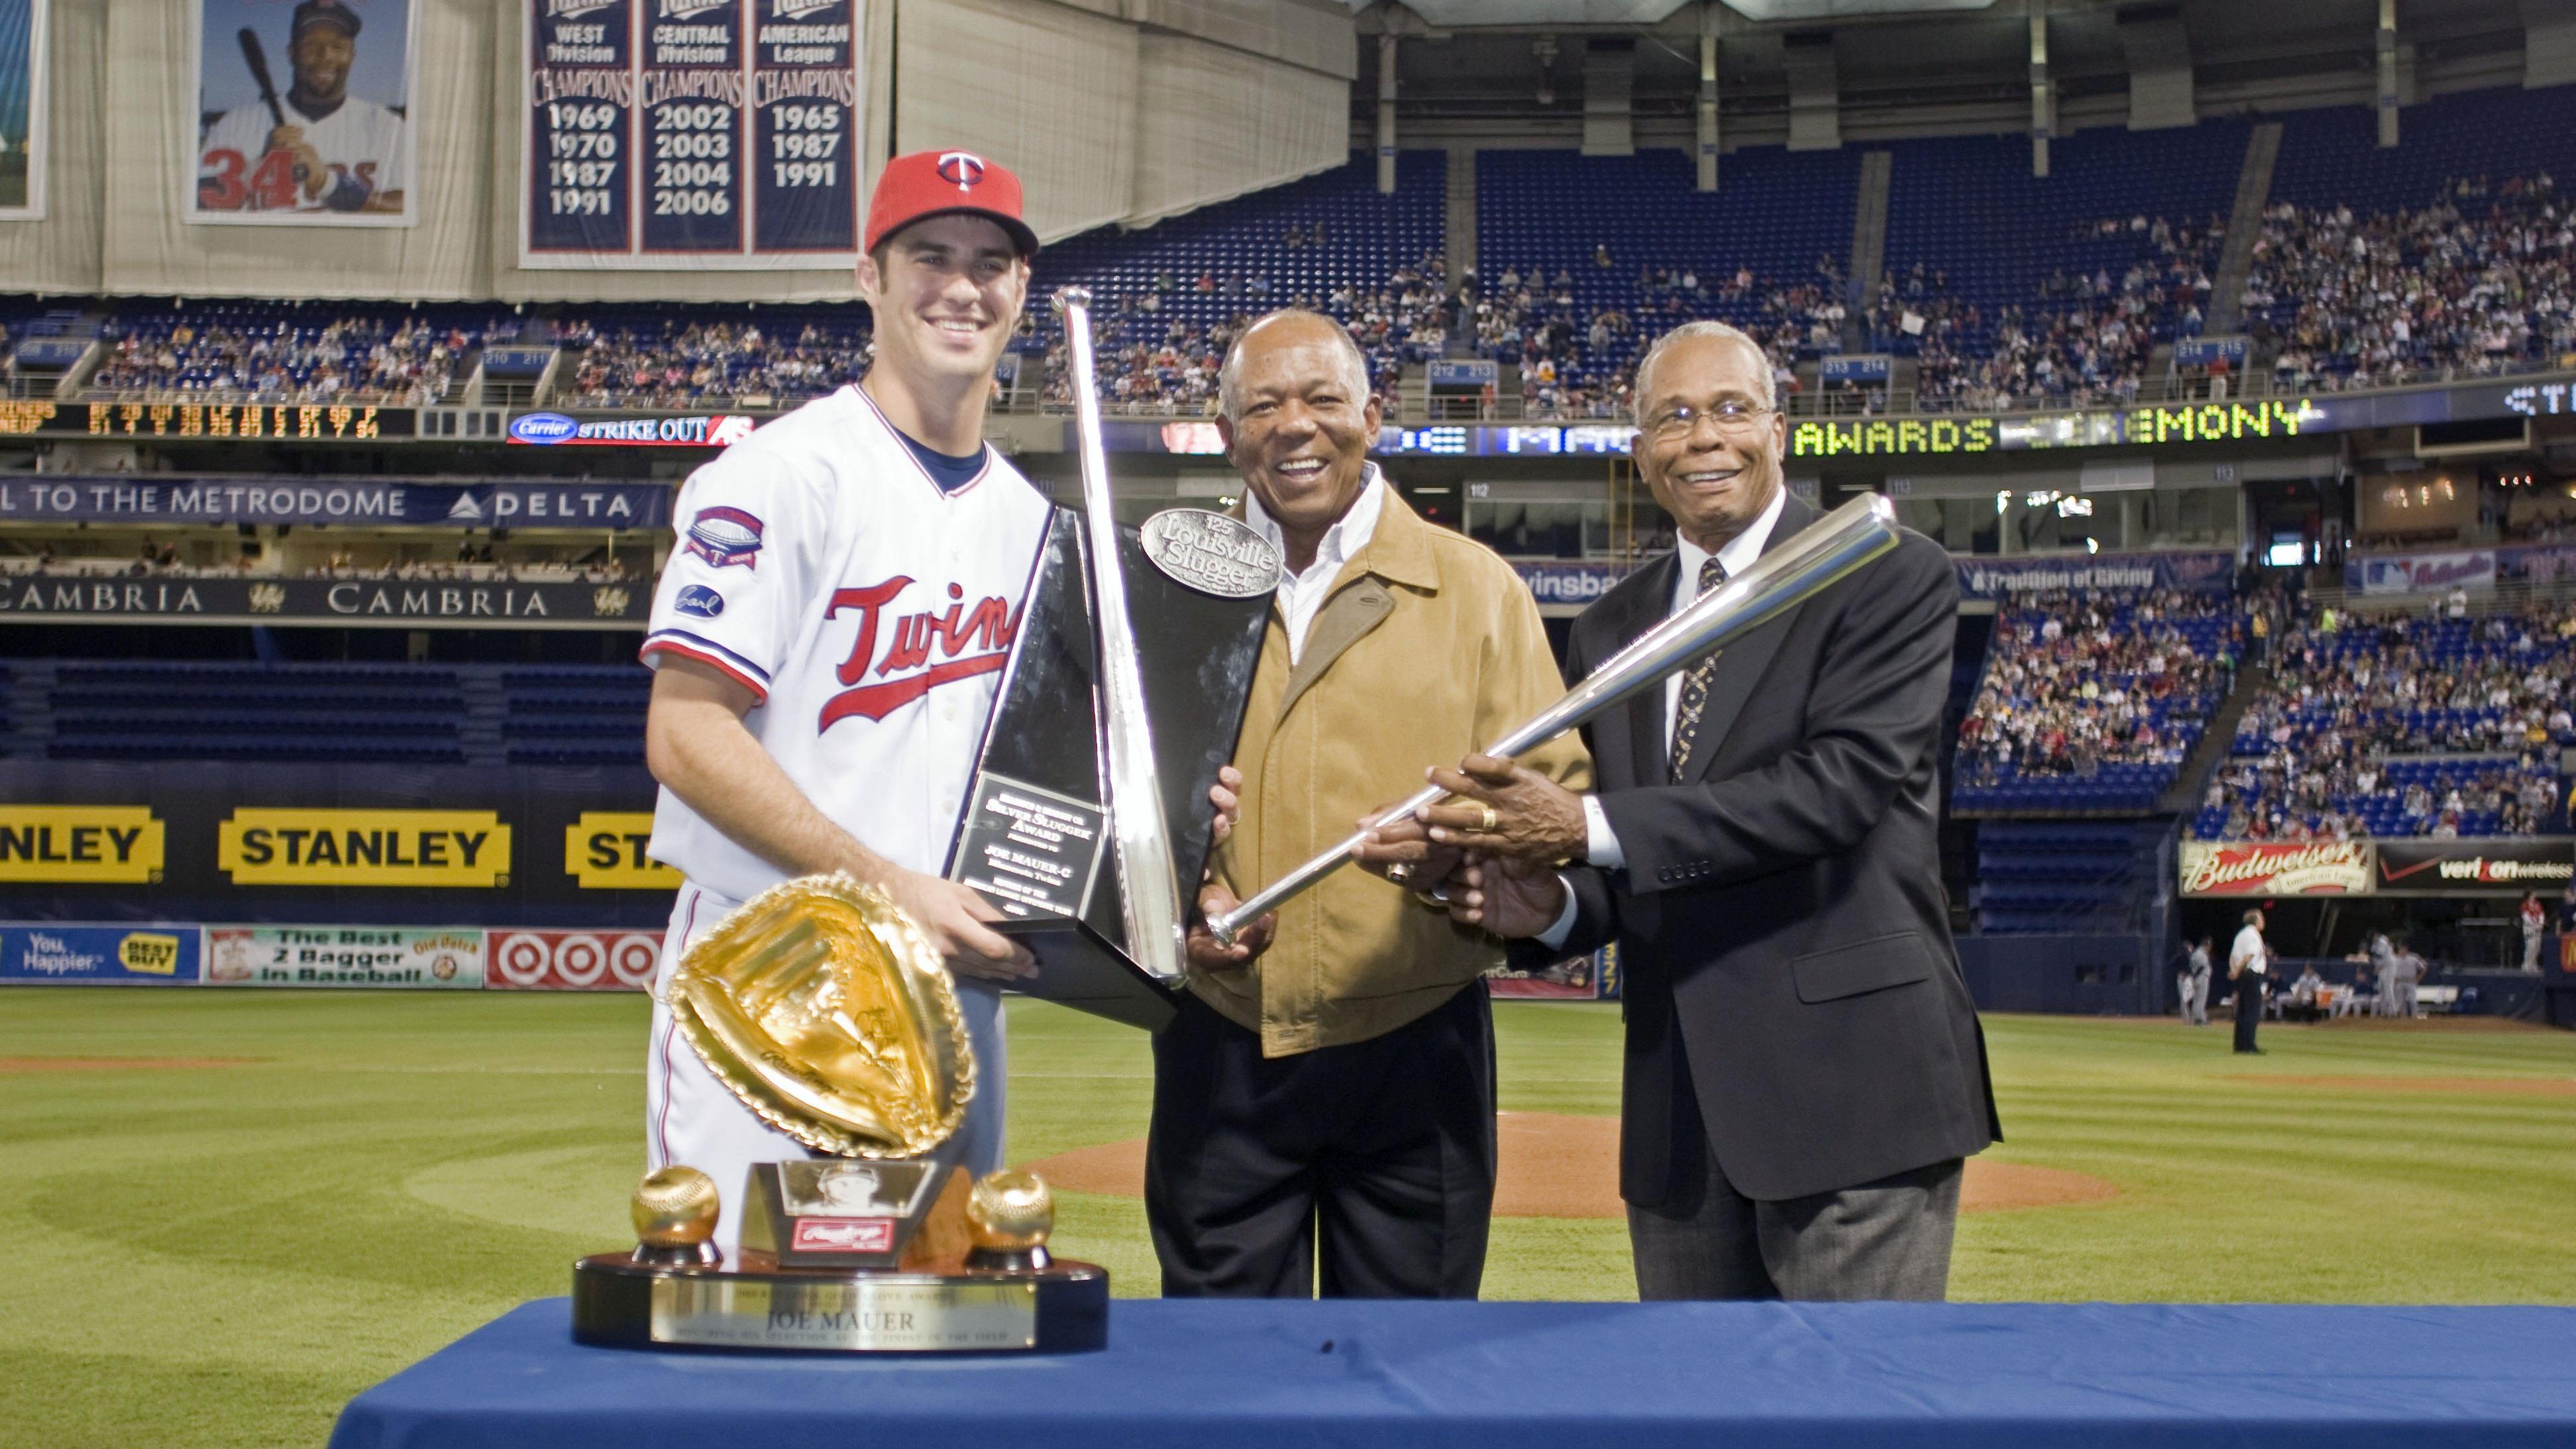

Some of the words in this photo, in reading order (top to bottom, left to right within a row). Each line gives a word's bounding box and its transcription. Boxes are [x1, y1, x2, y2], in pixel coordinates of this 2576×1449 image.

[555, 25, 606, 43] WEST
[653, 25, 729, 44] CENTRAL
[759, 25, 849, 44] AMERICAN
[547, 46, 615, 63] Division
[657, 46, 726, 63] Division
[774, 46, 836, 64] League
[531, 69, 632, 108] CHAMPIONS
[640, 69, 743, 109] CHAMPIONS
[753, 69, 855, 109] CHAMPIONS
[549, 104, 617, 130] 1969
[655, 105, 730, 130] 2002
[773, 105, 840, 130] 1965
[549, 133, 617, 158] 1970
[655, 134, 729, 158] 2003
[773, 133, 841, 158] 1987
[199, 148, 297, 210] 34
[549, 162, 617, 187] 1987
[655, 162, 730, 187] 2004
[774, 162, 837, 187] 1991
[549, 190, 611, 215] 1991
[655, 191, 729, 215] 2006
[486, 352, 508, 365] 210
[523, 352, 545, 365] 211
[1433, 365, 1455, 377] 212
[1825, 362, 1849, 373] 213
[996, 366, 1012, 379] 12
[299, 421, 320, 438] 21
[333, 423, 347, 439] 7
[518, 421, 570, 437] Carrier
[578, 419, 658, 439] STRIKE
[660, 417, 709, 442] OUT
[1794, 417, 1994, 456] AWARDS
[29, 486, 77, 512] TO
[89, 486, 158, 513] THE
[170, 486, 405, 515] METRODOME
[1470, 484, 1488, 497] 112
[496, 492, 631, 517] DELTA
[1162, 513, 1273, 571] Louisville
[1165, 541, 1252, 586] Slugger
[1971, 572, 1985, 591] A
[1988, 570, 2070, 590] Tradition
[2073, 568, 2090, 588] of
[2094, 568, 2155, 589] Giving
[328, 583, 550, 616] CAMBRIA
[824, 575, 1021, 692] Twin
[985, 798, 1033, 822] SILVER
[1032, 812, 1093, 840] SLUGGER
[1010, 820, 1061, 842] AWARD
[0, 826, 142, 863] NLEY
[241, 828, 489, 867] STANLEY
[985, 845, 1010, 860] JOE
[1012, 852, 1072, 878] MAUER-C
[2184, 841, 2357, 892] Budweiser
[2440, 856, 2517, 881] verizon
[2518, 861, 2573, 879] wireless
[29, 932, 67, 954] You,
[128, 941, 174, 957] BEST
[277, 930, 330, 945] The
[339, 930, 403, 945] Best
[128, 955, 167, 968] BUY
[273, 949, 288, 963] 2
[299, 949, 405, 968] Bagger
[298, 967, 421, 983] Baseball
[768, 1311, 814, 1330] JOE
[820, 1311, 914, 1331] MAUER
